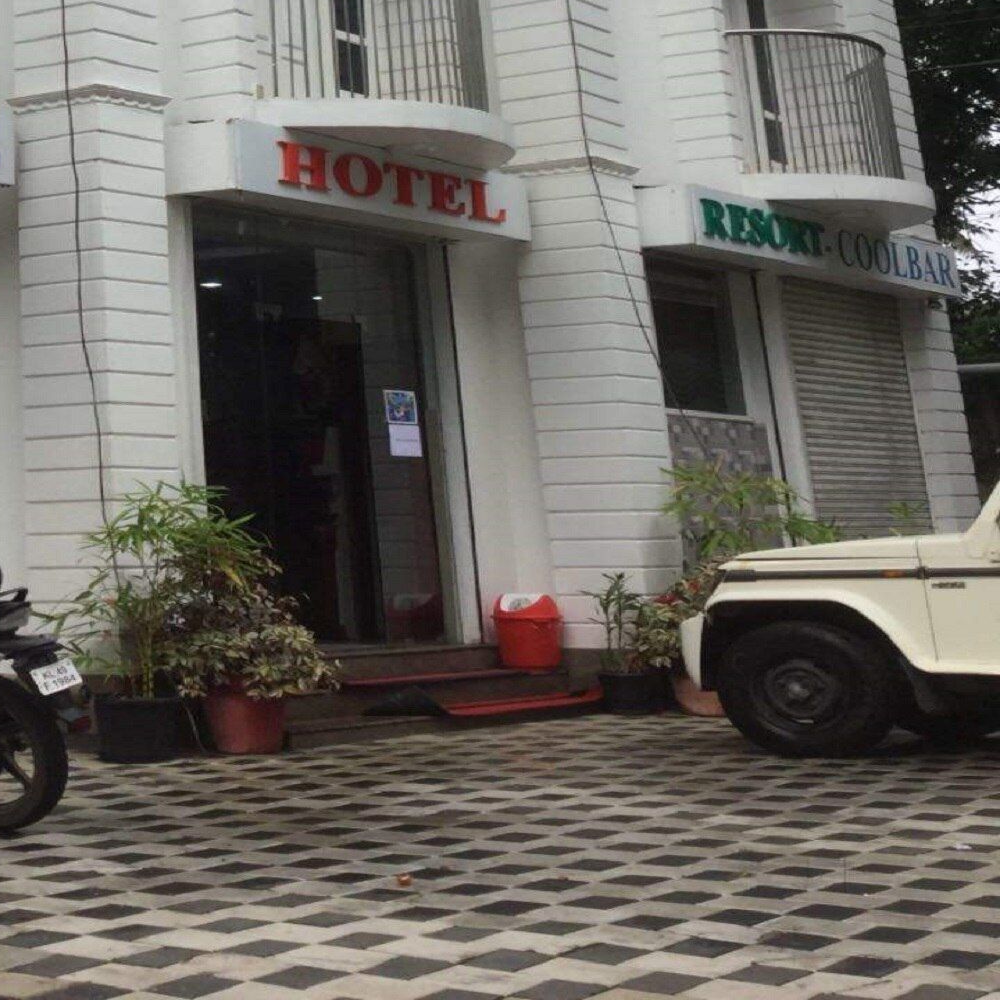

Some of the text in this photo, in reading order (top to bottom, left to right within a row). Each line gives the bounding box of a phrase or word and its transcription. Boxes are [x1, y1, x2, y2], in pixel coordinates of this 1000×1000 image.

[277, 140, 506, 223] HOTEL
[700, 198, 954, 288] RESORT COOLBAR
